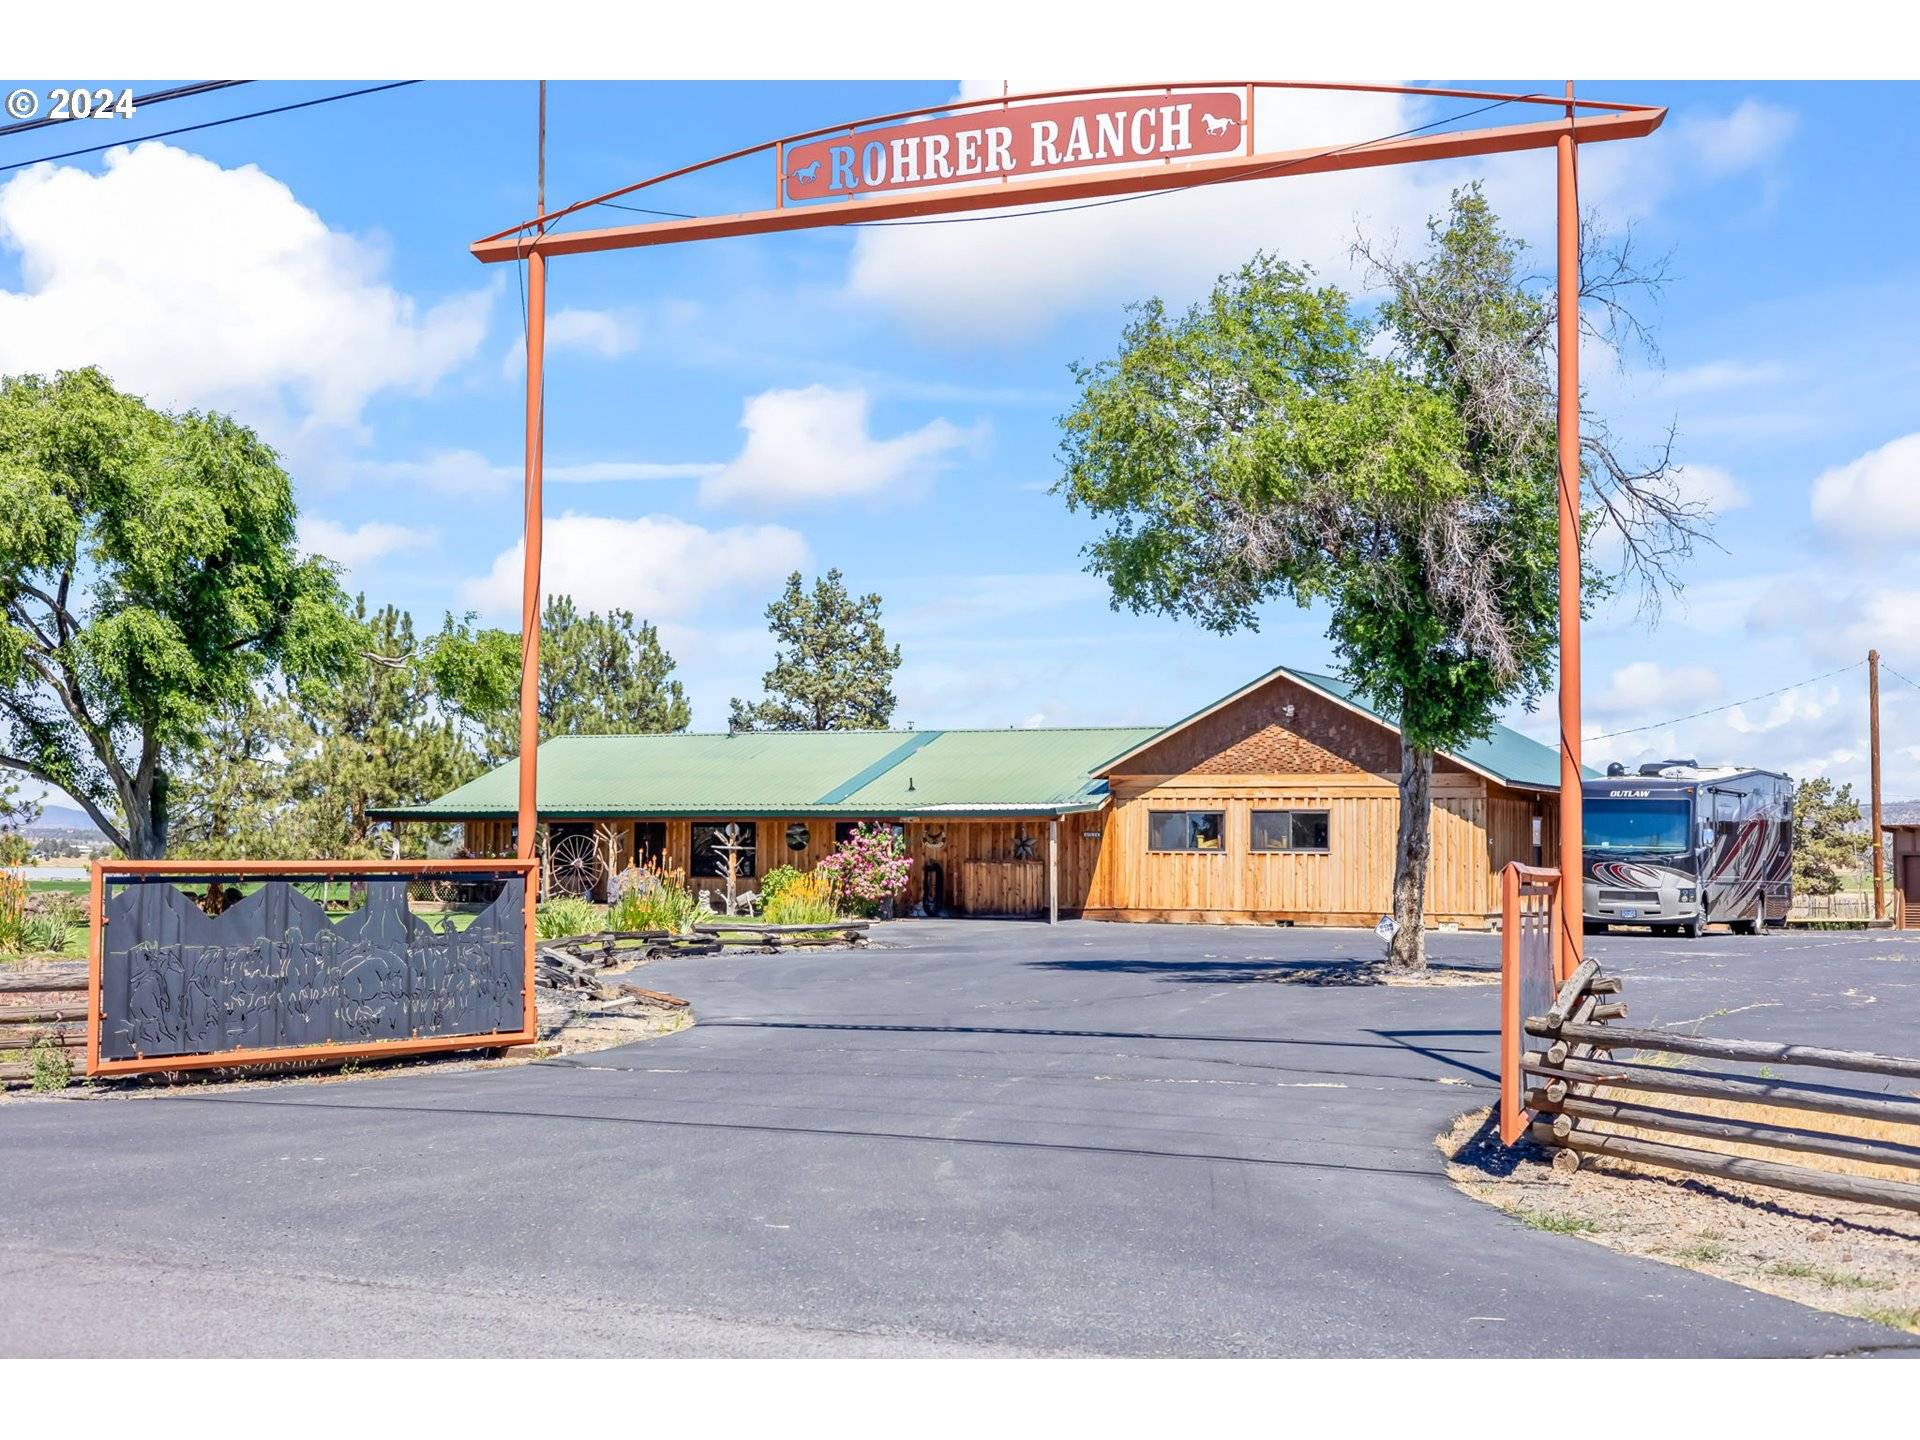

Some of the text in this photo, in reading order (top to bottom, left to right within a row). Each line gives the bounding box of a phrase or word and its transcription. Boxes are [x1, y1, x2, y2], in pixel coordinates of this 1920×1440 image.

[828, 103, 1193, 190] ROHRER RANCH
[1609, 790, 1650, 798] OUTLAW
